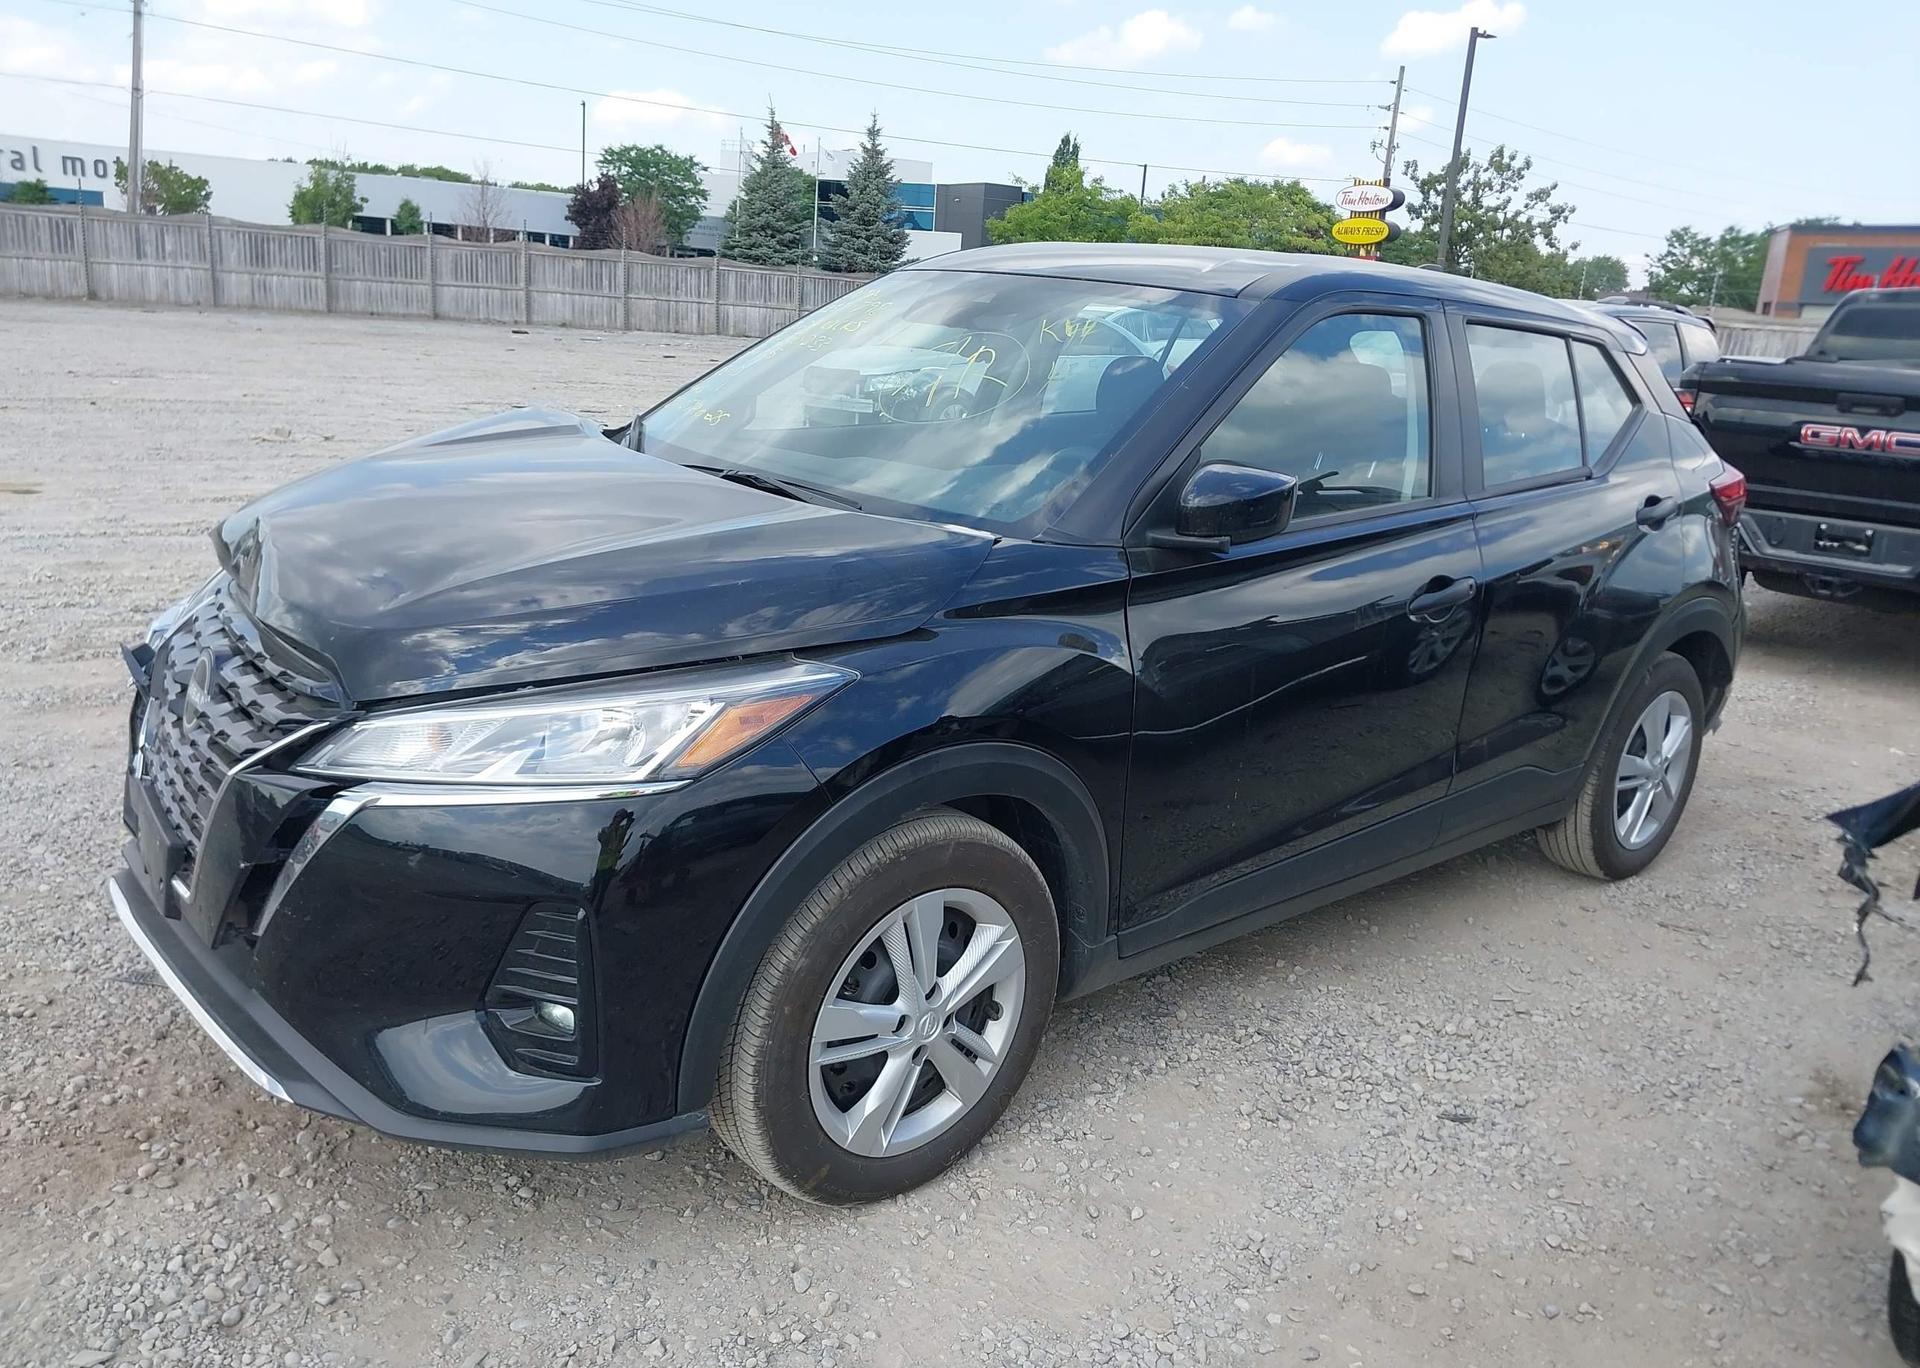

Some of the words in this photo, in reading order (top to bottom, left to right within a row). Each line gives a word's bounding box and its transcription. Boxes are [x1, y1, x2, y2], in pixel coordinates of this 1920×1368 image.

[1341, 191, 1357, 206] Tim
[1357, 190, 1389, 206] Hortons
[1335, 226, 1362, 236] ALWAYS
[1361, 227, 1386, 236] FRESH
[1823, 255, 1875, 293] Tim
[1800, 422, 1920, 456] GMC
